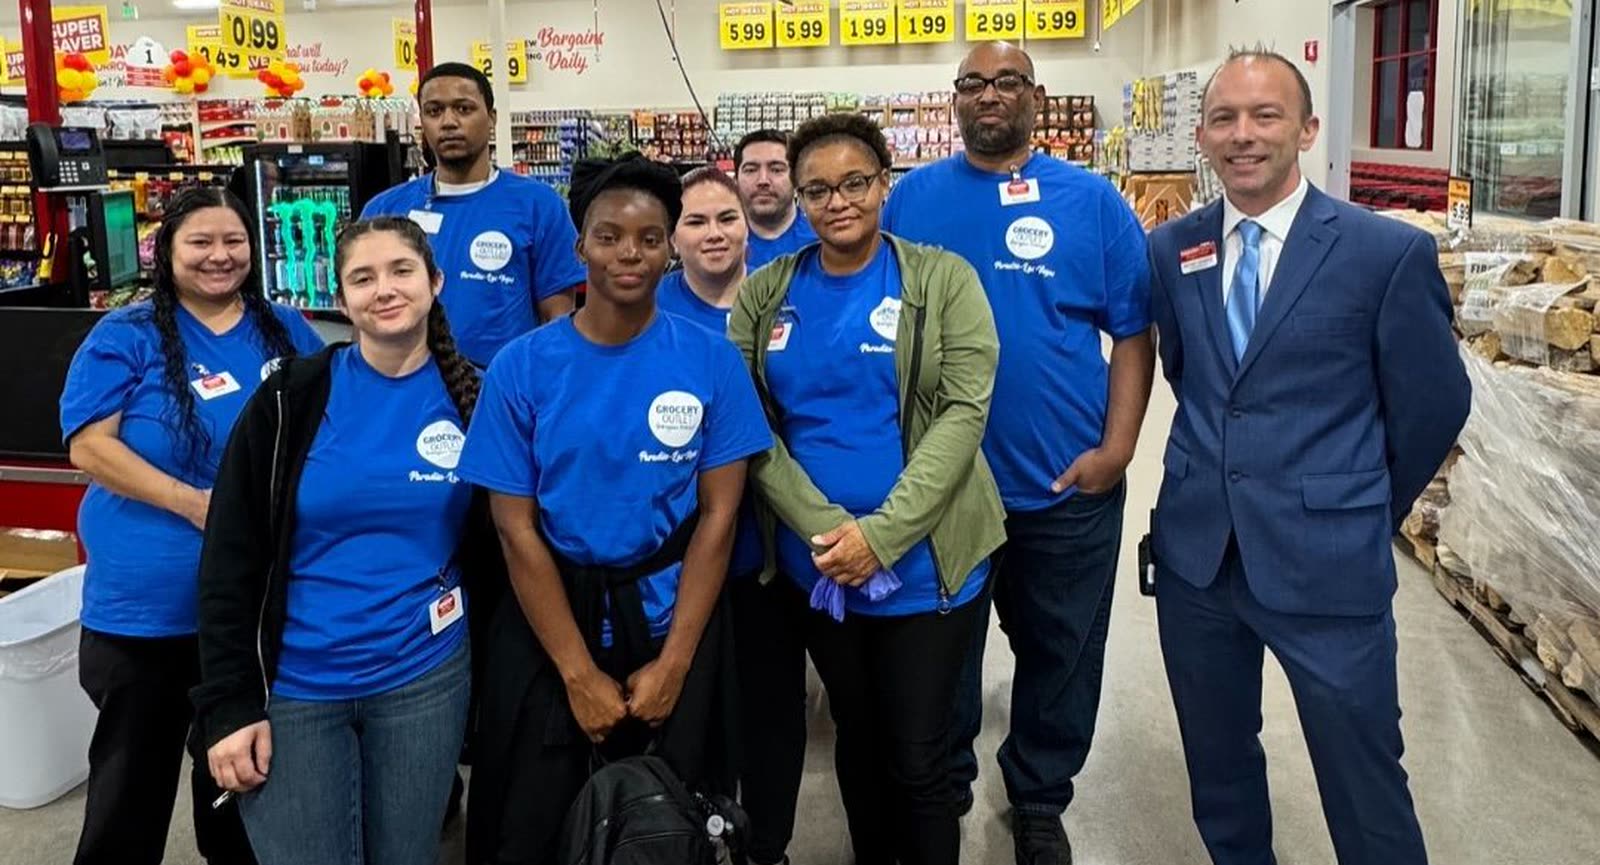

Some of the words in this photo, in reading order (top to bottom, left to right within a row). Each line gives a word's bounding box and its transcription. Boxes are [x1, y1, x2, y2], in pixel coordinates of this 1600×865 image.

[787, 20, 822, 41] 5.99
[851, 18, 887, 39] 1.99
[909, 15, 946, 36] 1.99
[977, 13, 1017, 34] 2.99
[1037, 11, 1077, 32] 5.99
[233, 16, 279, 50] 0.99
[537, 27, 604, 51] Bargains
[730, 23, 765, 43] 5.99
[145, 49, 153, 64] 1
[312, 58, 350, 77] today?
[656, 404, 699, 415] GROCERY
